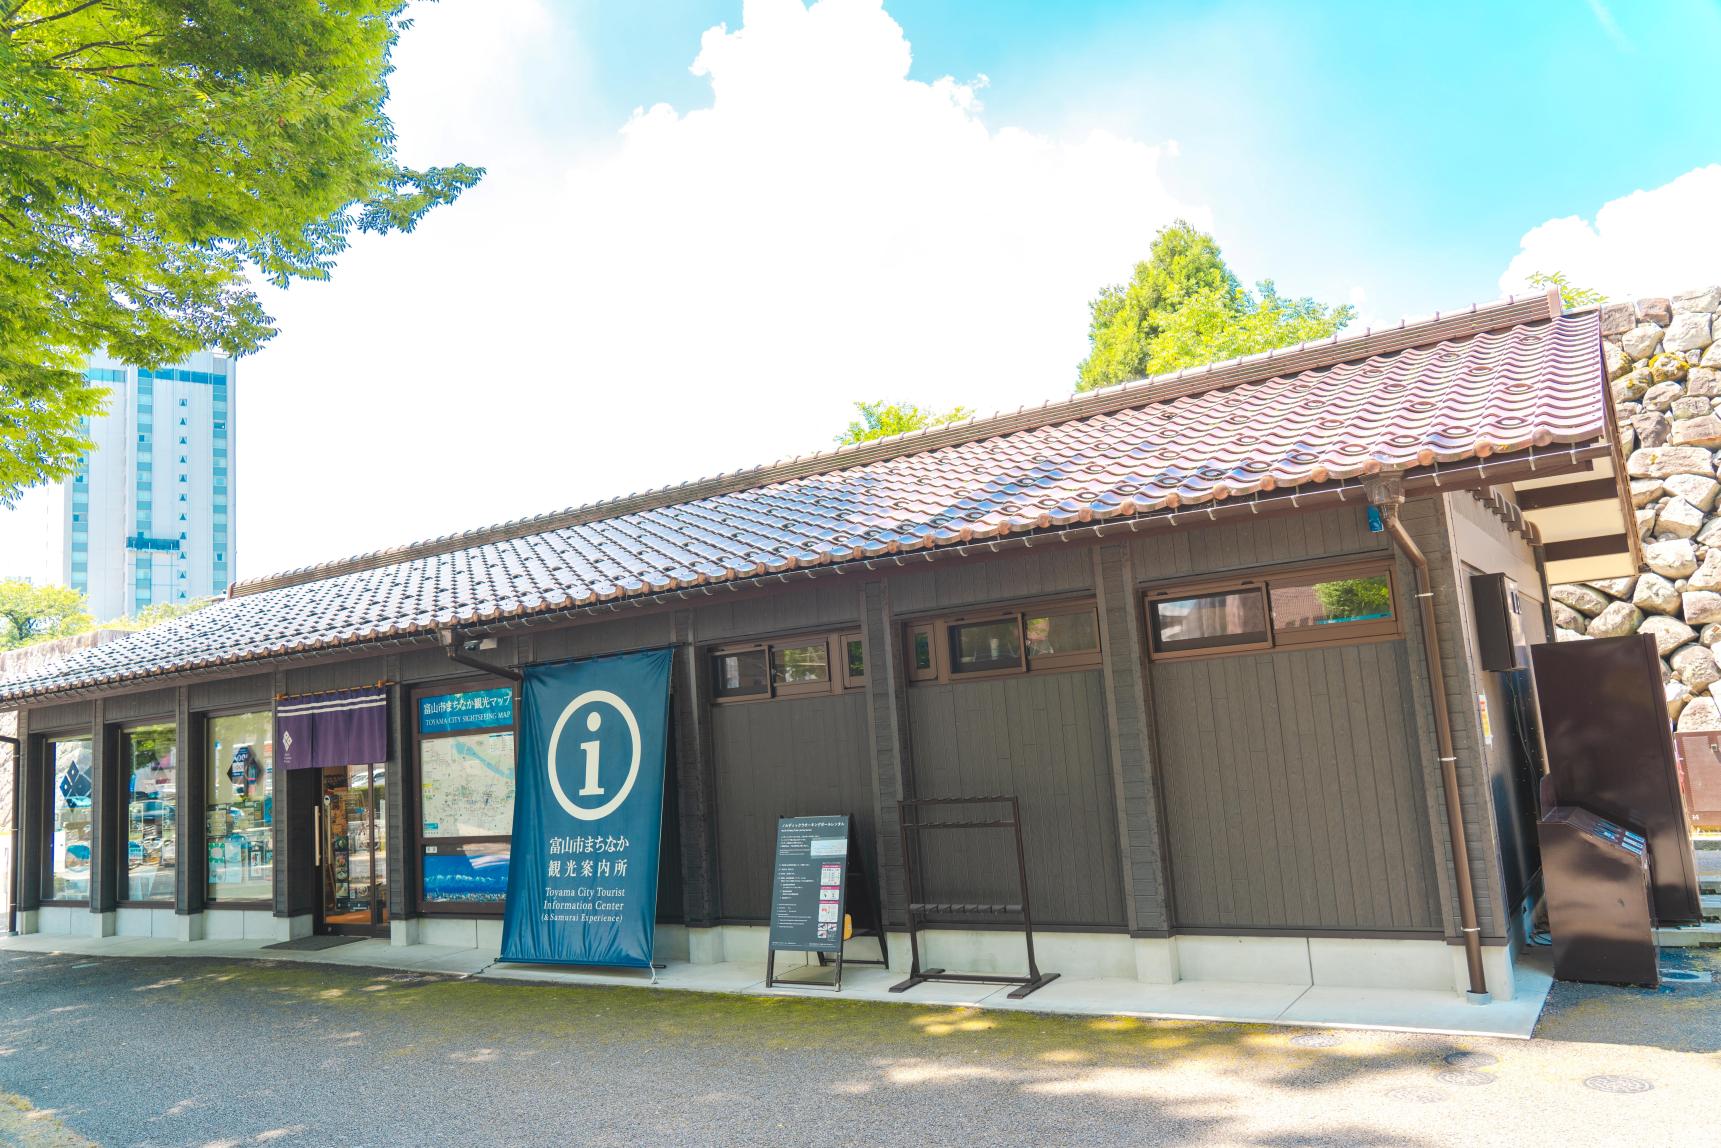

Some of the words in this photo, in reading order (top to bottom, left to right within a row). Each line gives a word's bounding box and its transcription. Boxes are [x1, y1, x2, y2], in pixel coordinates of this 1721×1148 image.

[423, 695, 511, 714] 富山市まちなか観光マップ
[426, 718, 447, 726] TOYAMA
[448, 716, 462, 724] CITY
[462, 713, 496, 721] SIGHTSEEING
[549, 835, 630, 854] 富山市まちなか
[548, 858, 628, 878] 観光案内所
[545, 887, 575, 899] Toyama
[577, 887, 594, 900] City
[596, 887, 625, 897] Tourist
[543, 900, 593, 910] Information
[595, 900, 624, 910] Center
[581, 913, 623, 924] Experience)
